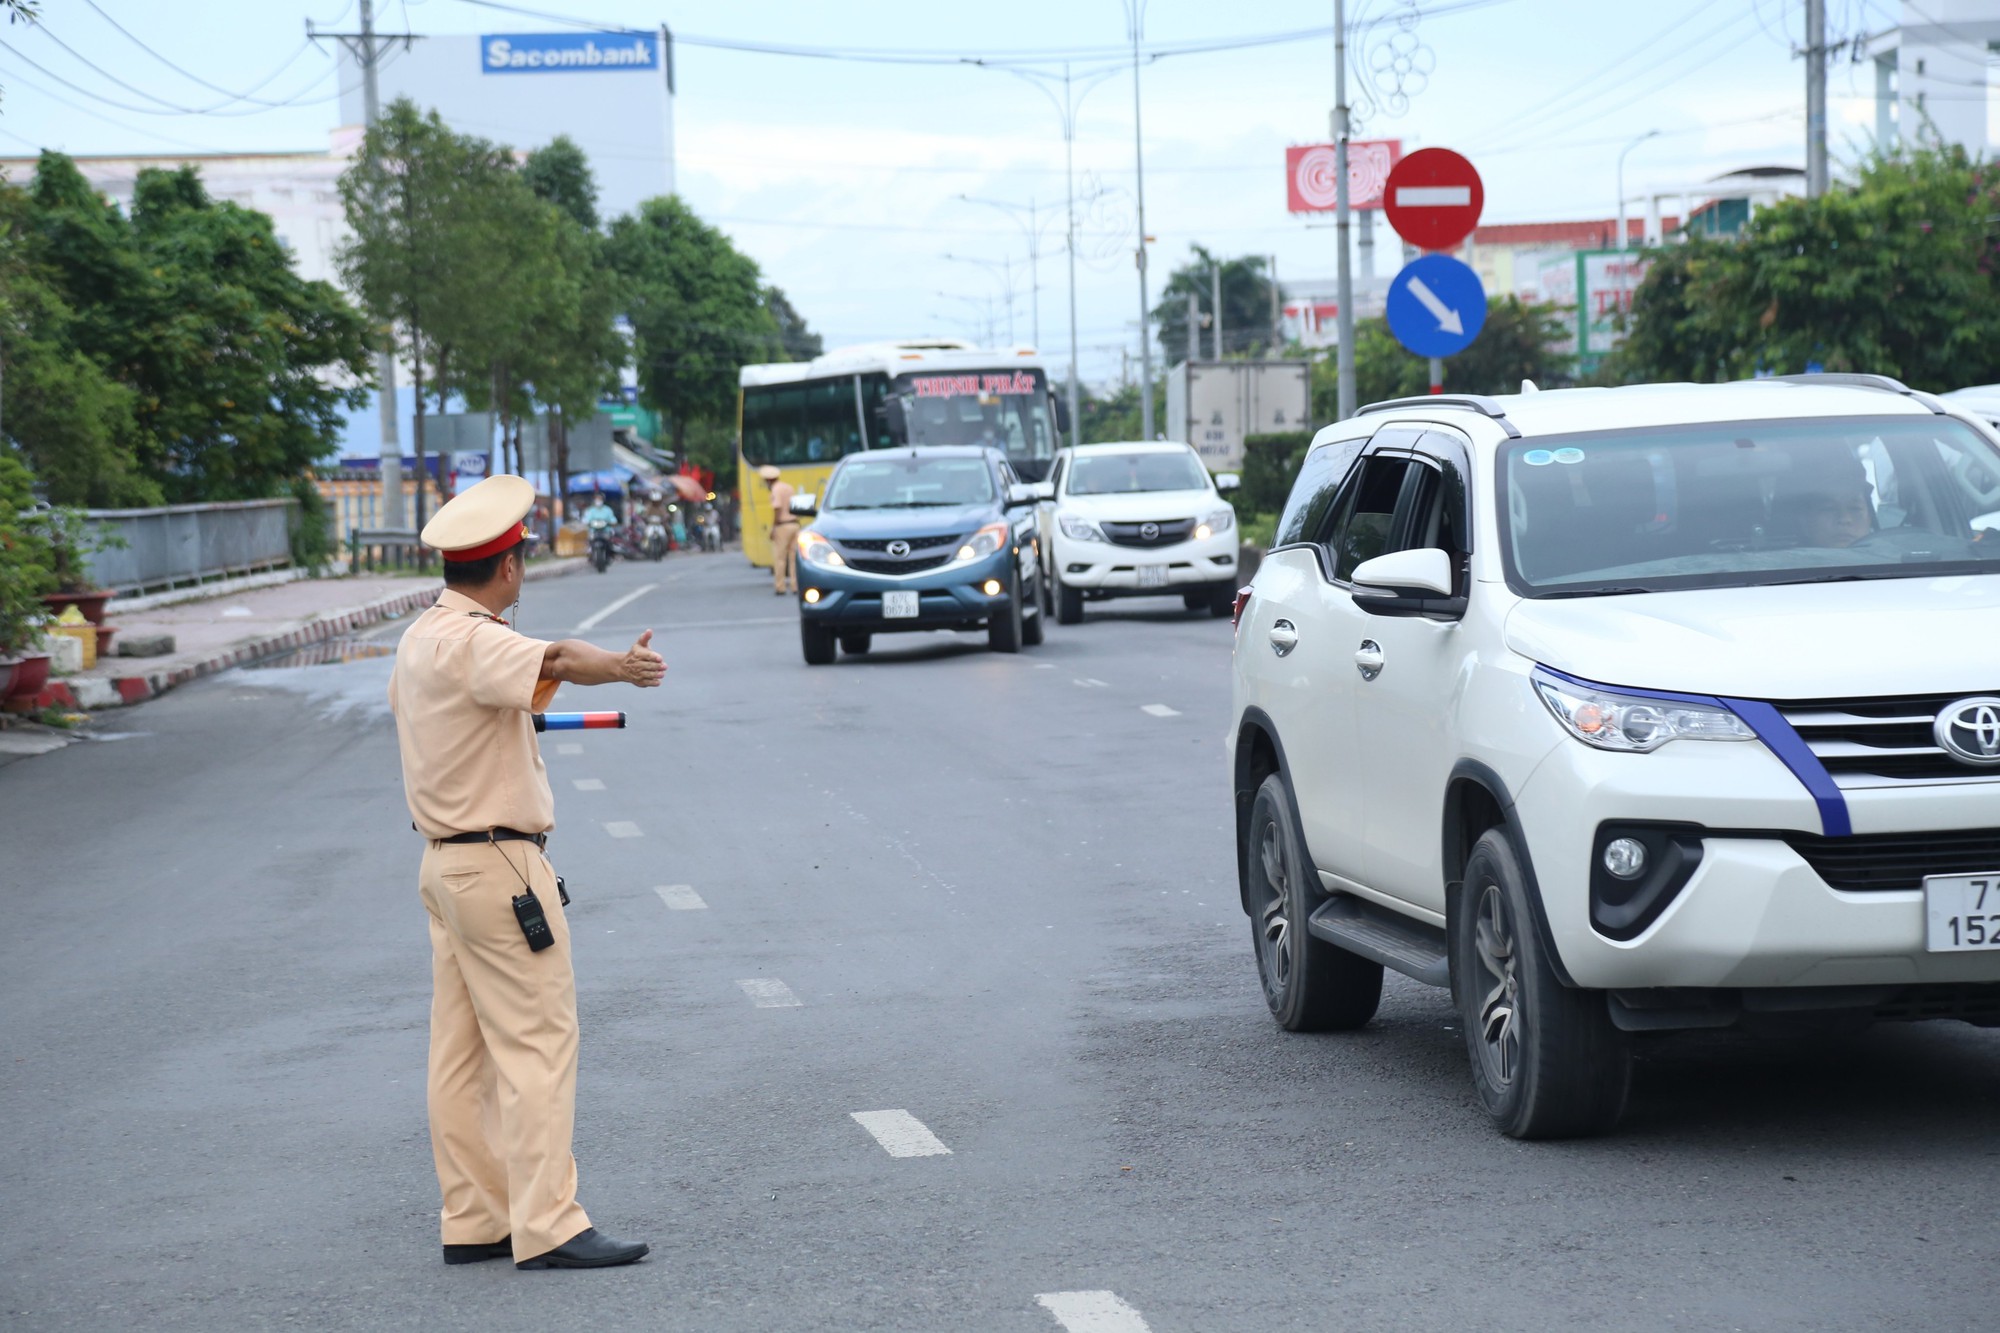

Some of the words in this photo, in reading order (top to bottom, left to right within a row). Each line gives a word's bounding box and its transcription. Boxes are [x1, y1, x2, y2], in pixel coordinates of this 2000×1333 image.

[487, 40, 651, 68] Sacombank
[912, 375, 980, 400] THỊNH
[983, 370, 1036, 395] PHÁT
[1970, 880, 2000, 910] 7
